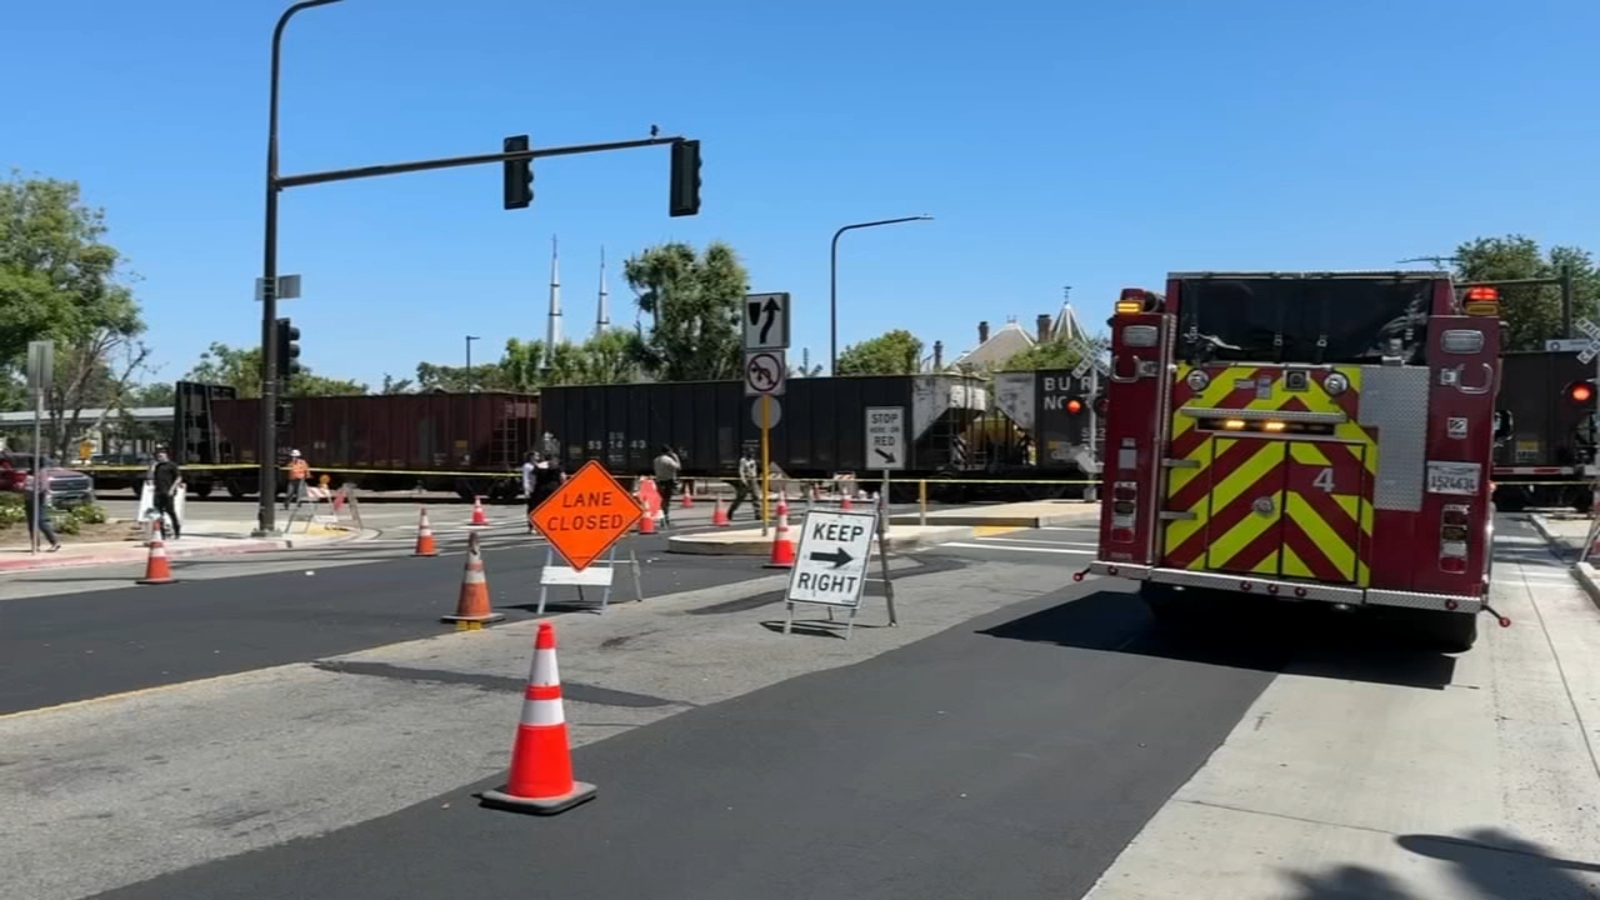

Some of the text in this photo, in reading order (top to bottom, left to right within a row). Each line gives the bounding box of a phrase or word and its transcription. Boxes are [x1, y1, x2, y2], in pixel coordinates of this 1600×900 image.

[871, 413, 898, 424] STOP
[873, 435, 895, 447] RED
[1312, 467, 1335, 492] 4
[562, 491, 612, 508] LANE
[547, 514, 624, 531] CLOSED
[813, 522, 864, 542] KEEP
[797, 572, 858, 594] RIGHT
